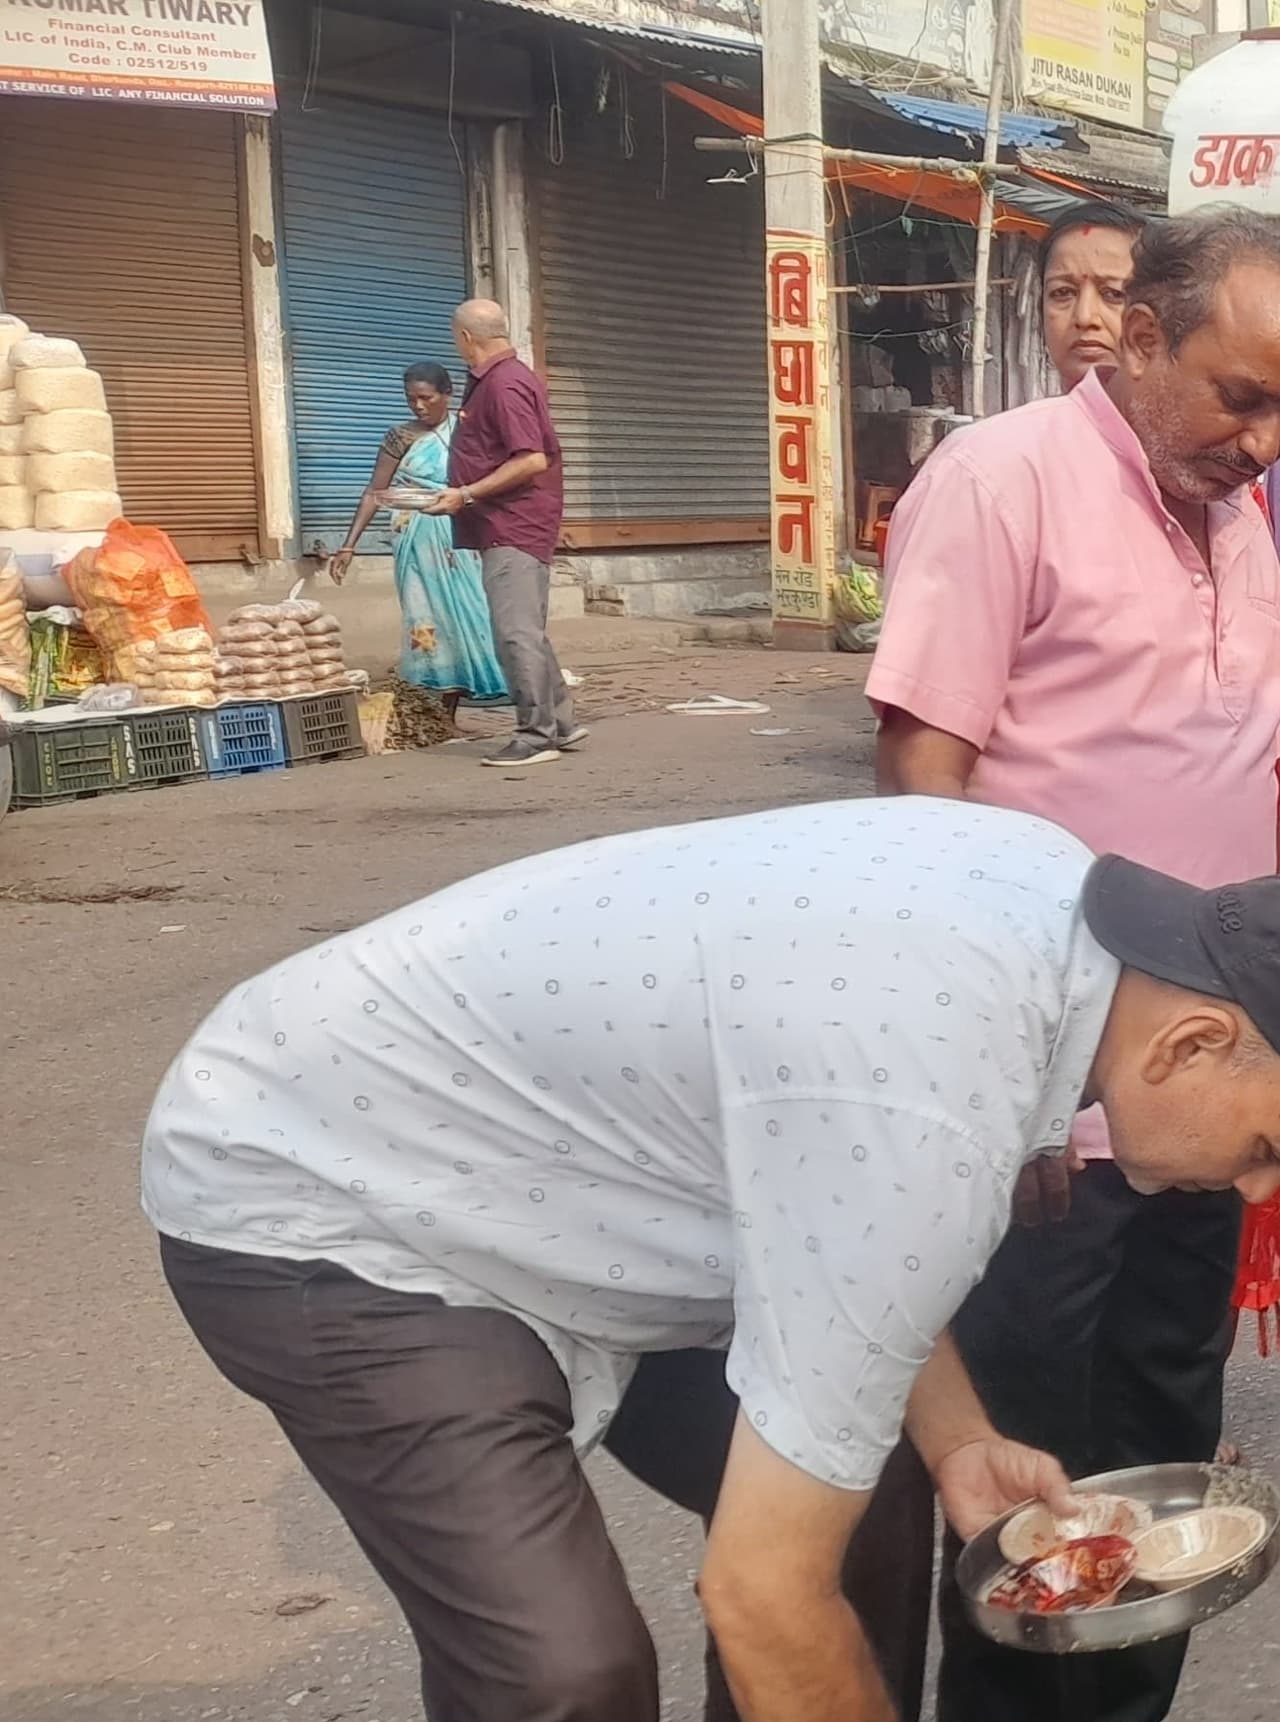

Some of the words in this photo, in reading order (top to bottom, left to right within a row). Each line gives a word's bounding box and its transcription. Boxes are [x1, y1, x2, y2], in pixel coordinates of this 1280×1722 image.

[142, 0, 252, 27] TIWARY
[48, 18, 125, 34] Financial
[131, 25, 217, 41] Consultant
[4, 30, 35, 43] LIC
[40, 34, 57, 45] of
[157, 43, 192, 56] Club
[197, 45, 257, 60] Member
[68, 52, 111, 66] Code
[126, 57, 208, 72] 02512/519
[1031, 56, 1053, 78] JITU
[1056, 63, 1094, 89] RASAN
[1096, 75, 1132, 100] DUKAN
[11, 81, 67, 95] SERVICE
[68, 85, 86, 96] OF
[92, 87, 113, 98] LIC
[118, 89, 142, 99] ANY
[145, 90, 207, 103] FINANCIAL
[208, 93, 265, 106] SOLUTION
